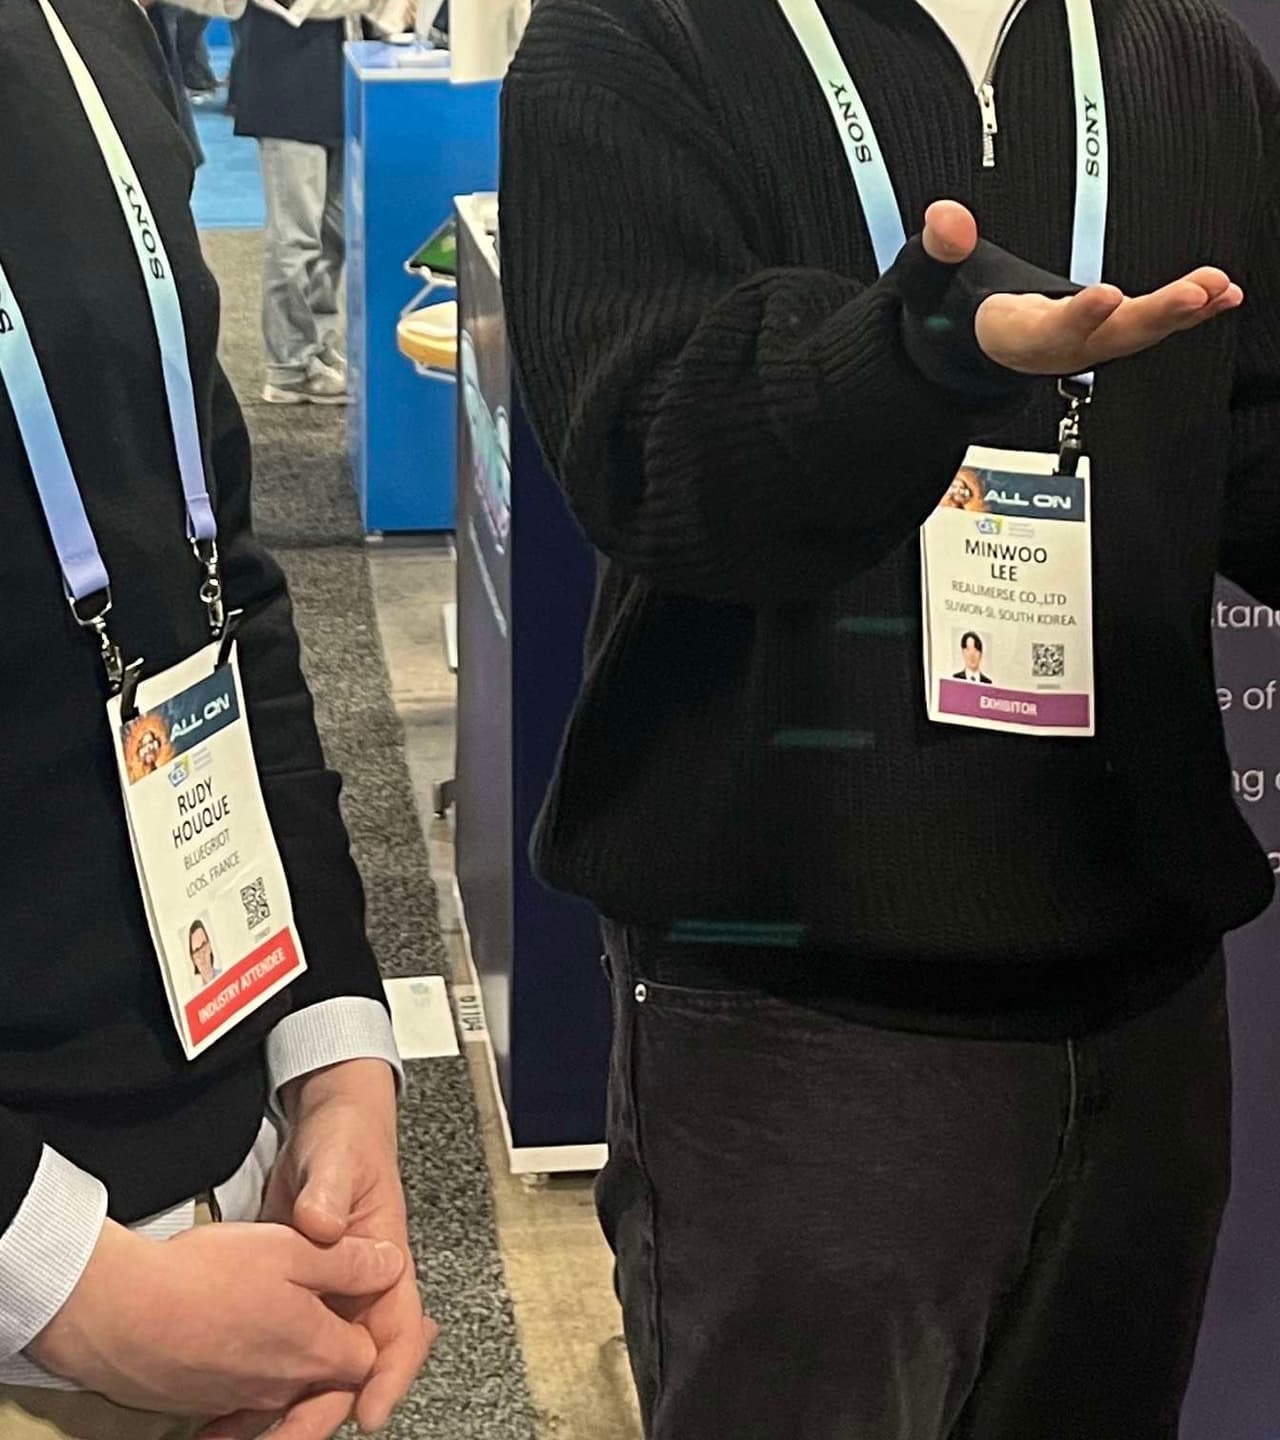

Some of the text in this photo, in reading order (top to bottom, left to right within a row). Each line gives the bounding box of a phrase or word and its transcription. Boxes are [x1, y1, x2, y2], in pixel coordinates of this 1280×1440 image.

[829, 79, 873, 164] SONY
[1083, 94, 1101, 178] SONY
[118, 175, 166, 281] SONY
[983, 489, 1072, 510] ALL ON
[964, 538, 1048, 564] MINWOO
[990, 563, 1018, 582] LEE
[1037, 613, 1078, 627] KOREA
[1242, 679, 1278, 711] of
[170, 691, 231, 742] ALL ON
[177, 776, 213, 817] RUDY
[172, 794, 231, 849] HOUQUE
